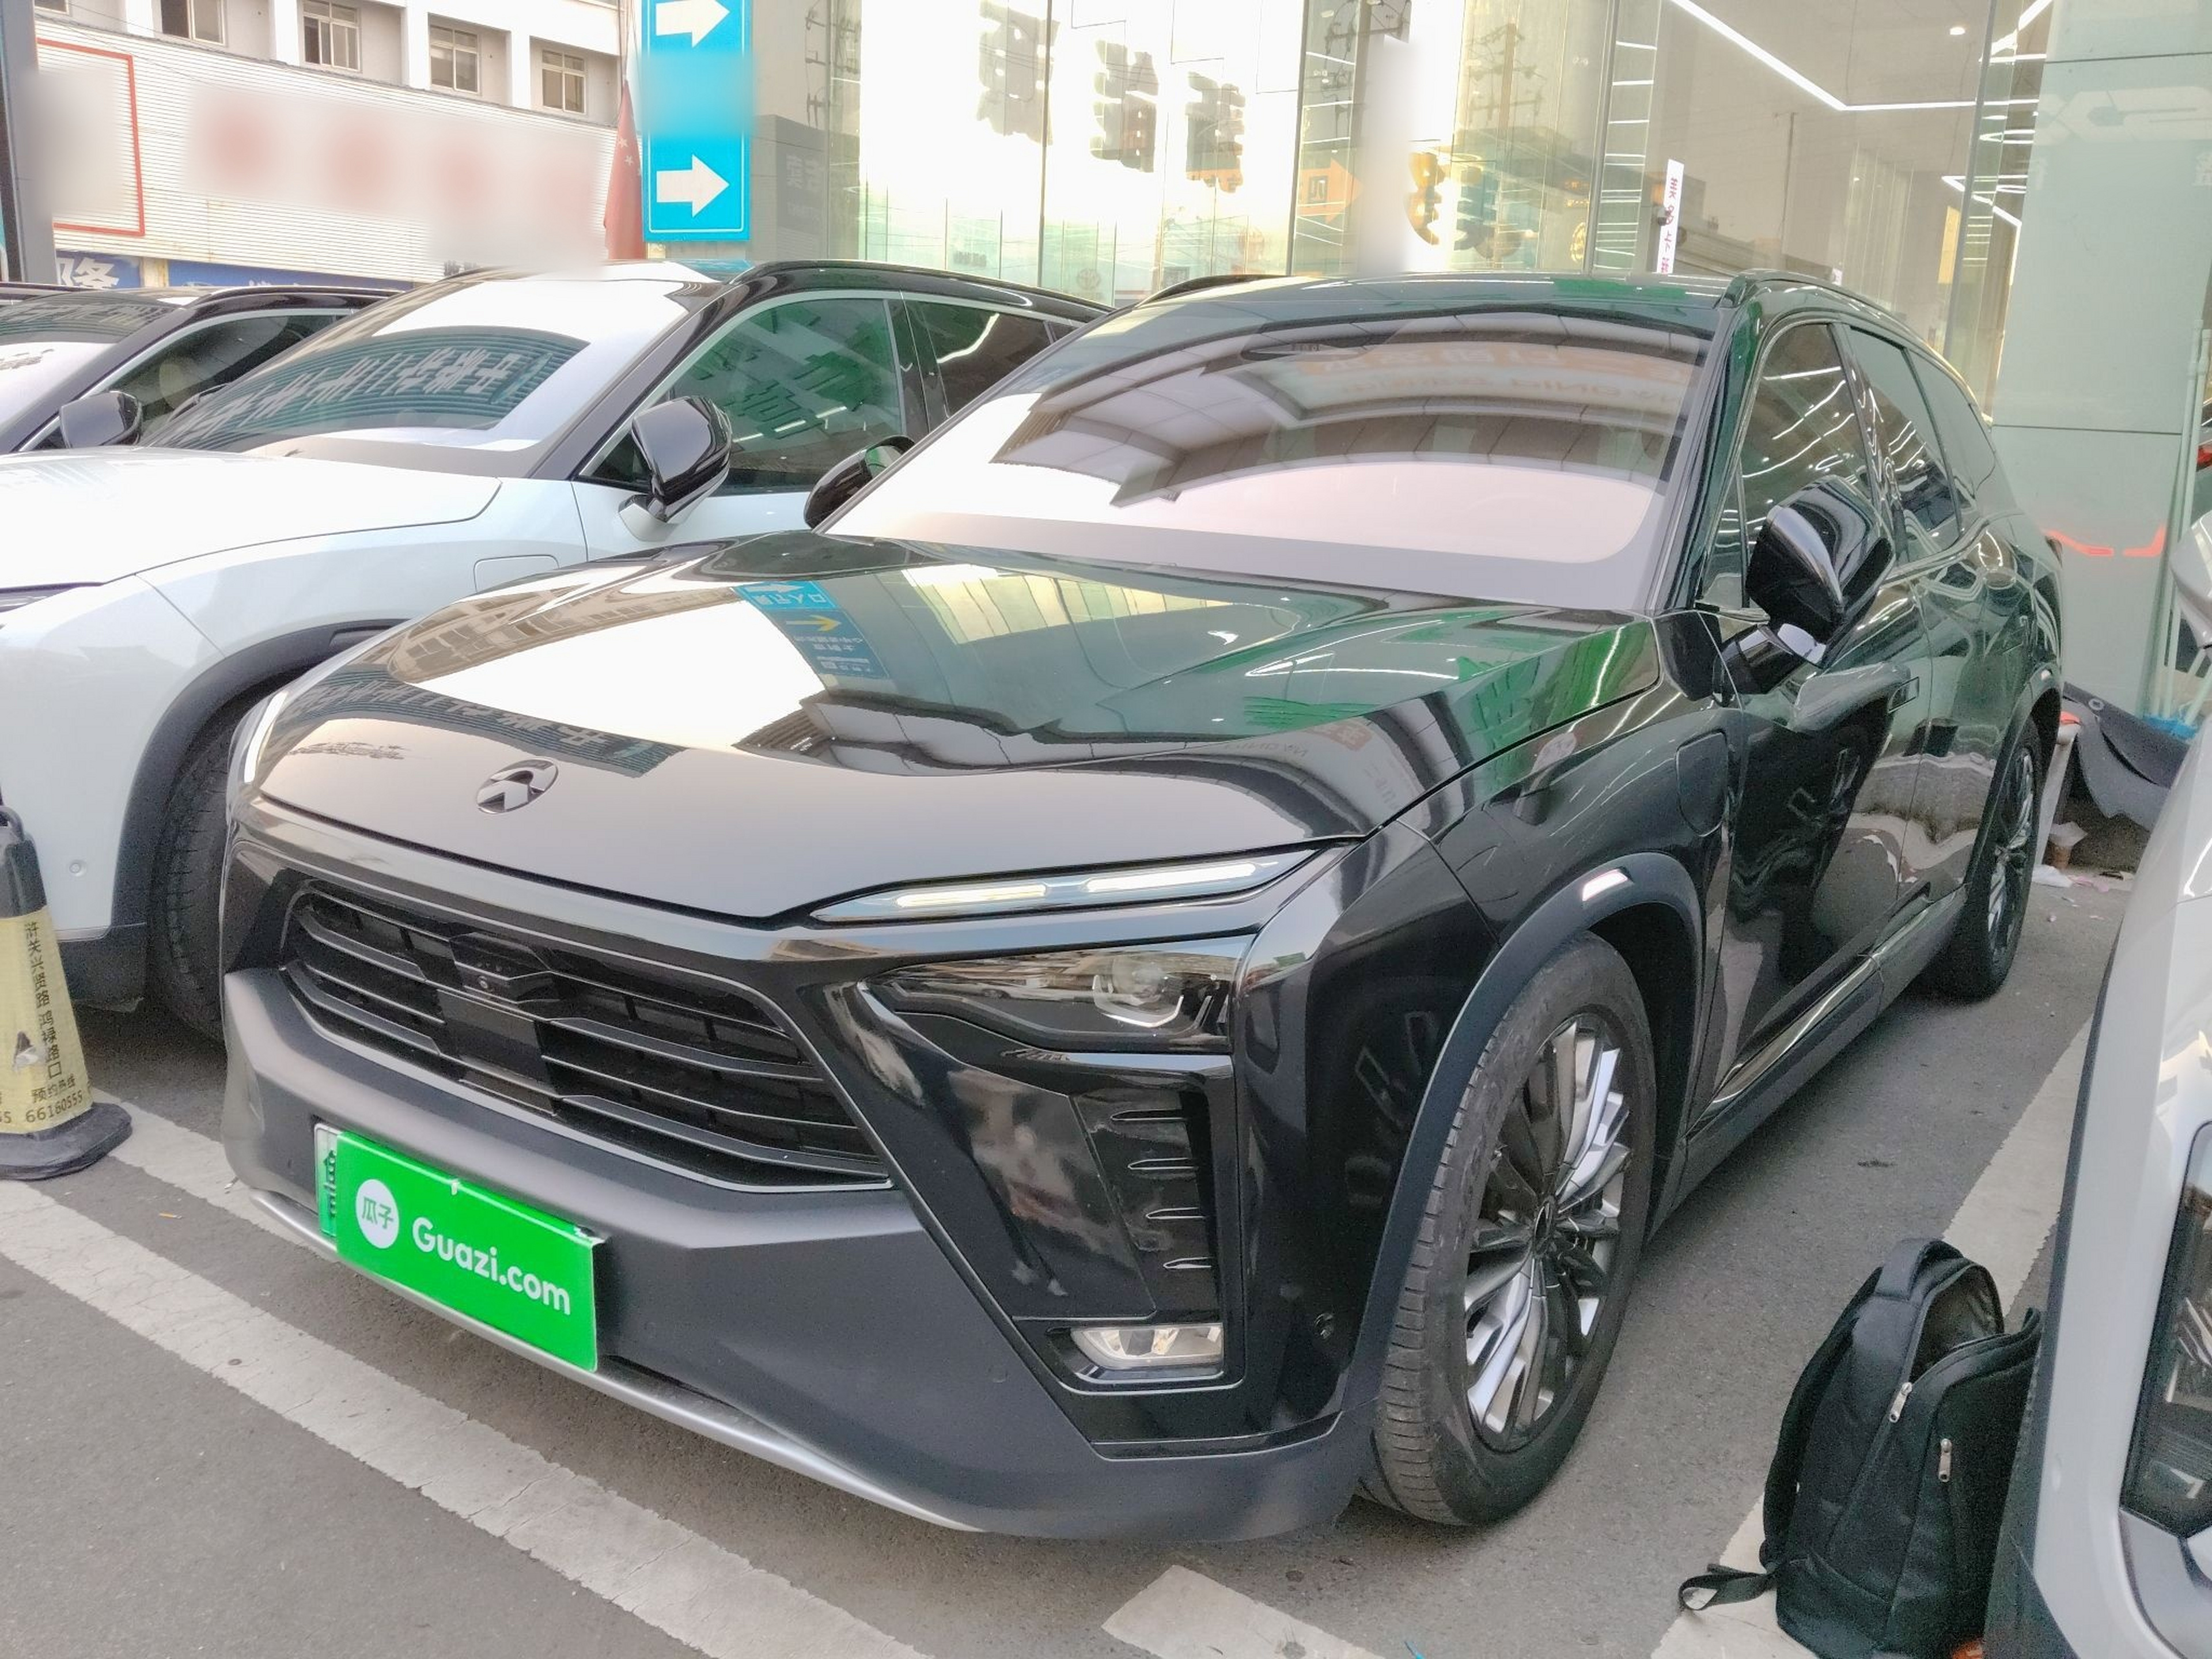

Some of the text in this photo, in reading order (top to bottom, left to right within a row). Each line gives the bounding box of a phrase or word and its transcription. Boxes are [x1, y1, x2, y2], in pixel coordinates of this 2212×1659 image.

[25, 1089, 83, 1123] 66160555
[362, 1196, 394, 1230] 瓜子
[412, 1217, 571, 1316] Guazi.com
